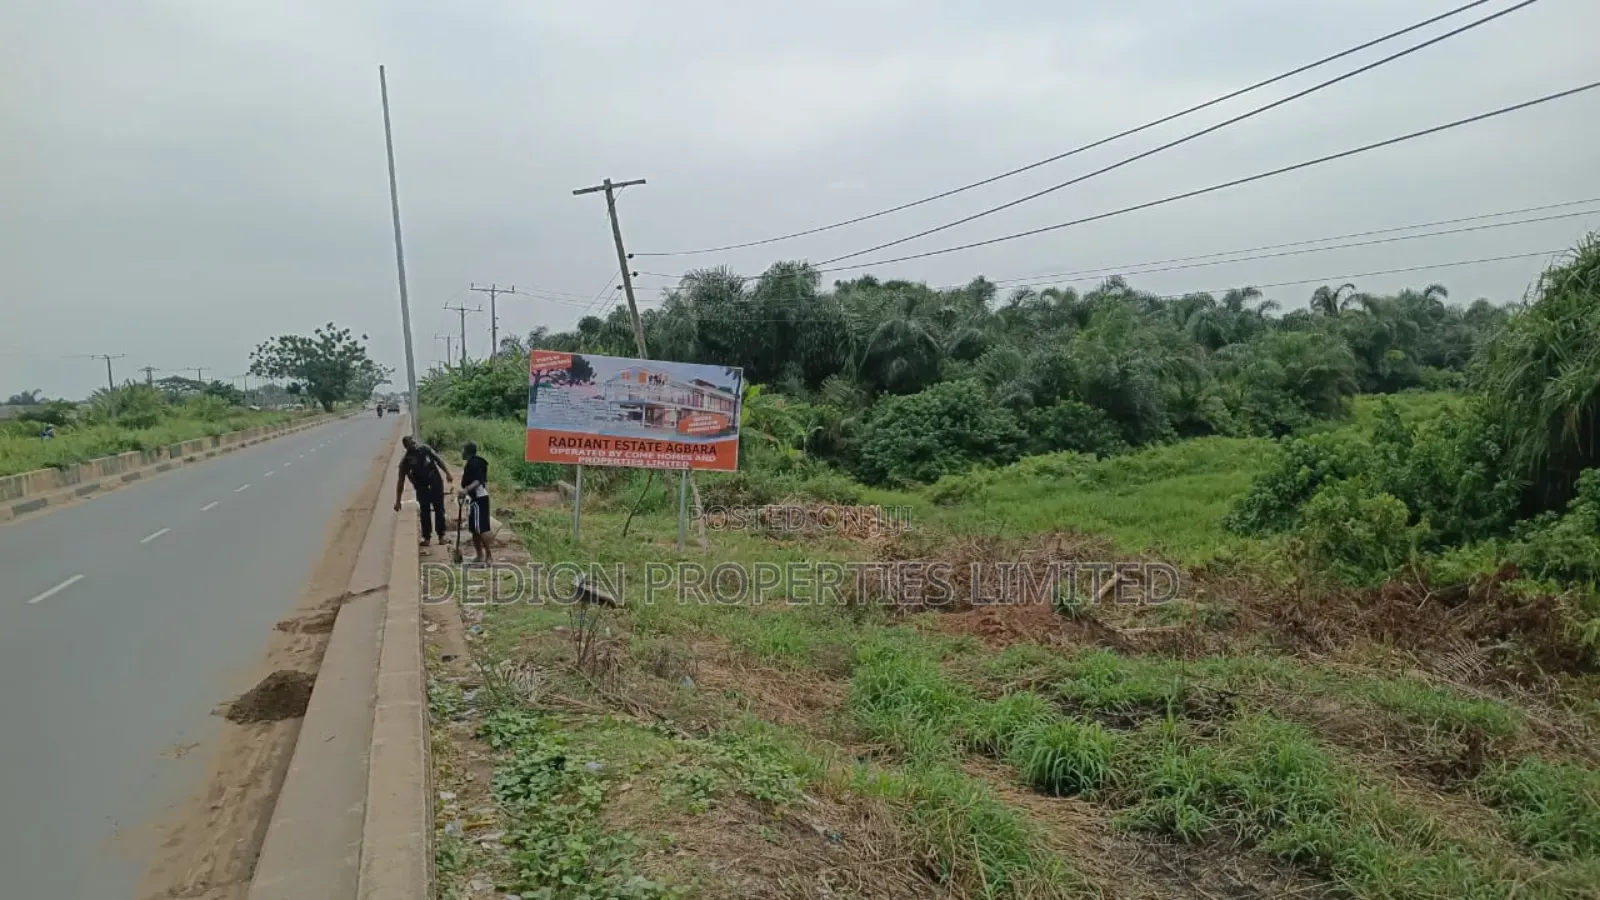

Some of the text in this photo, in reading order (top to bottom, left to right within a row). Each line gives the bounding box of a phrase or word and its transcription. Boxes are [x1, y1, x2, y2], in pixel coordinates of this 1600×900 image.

[548, 436, 717, 455] RADIANT ESTATE AGBARA
[549, 447, 716, 462] OPERATED BY COME HOMES AND
[578, 456, 690, 468] PROPERTIES LIMITED
